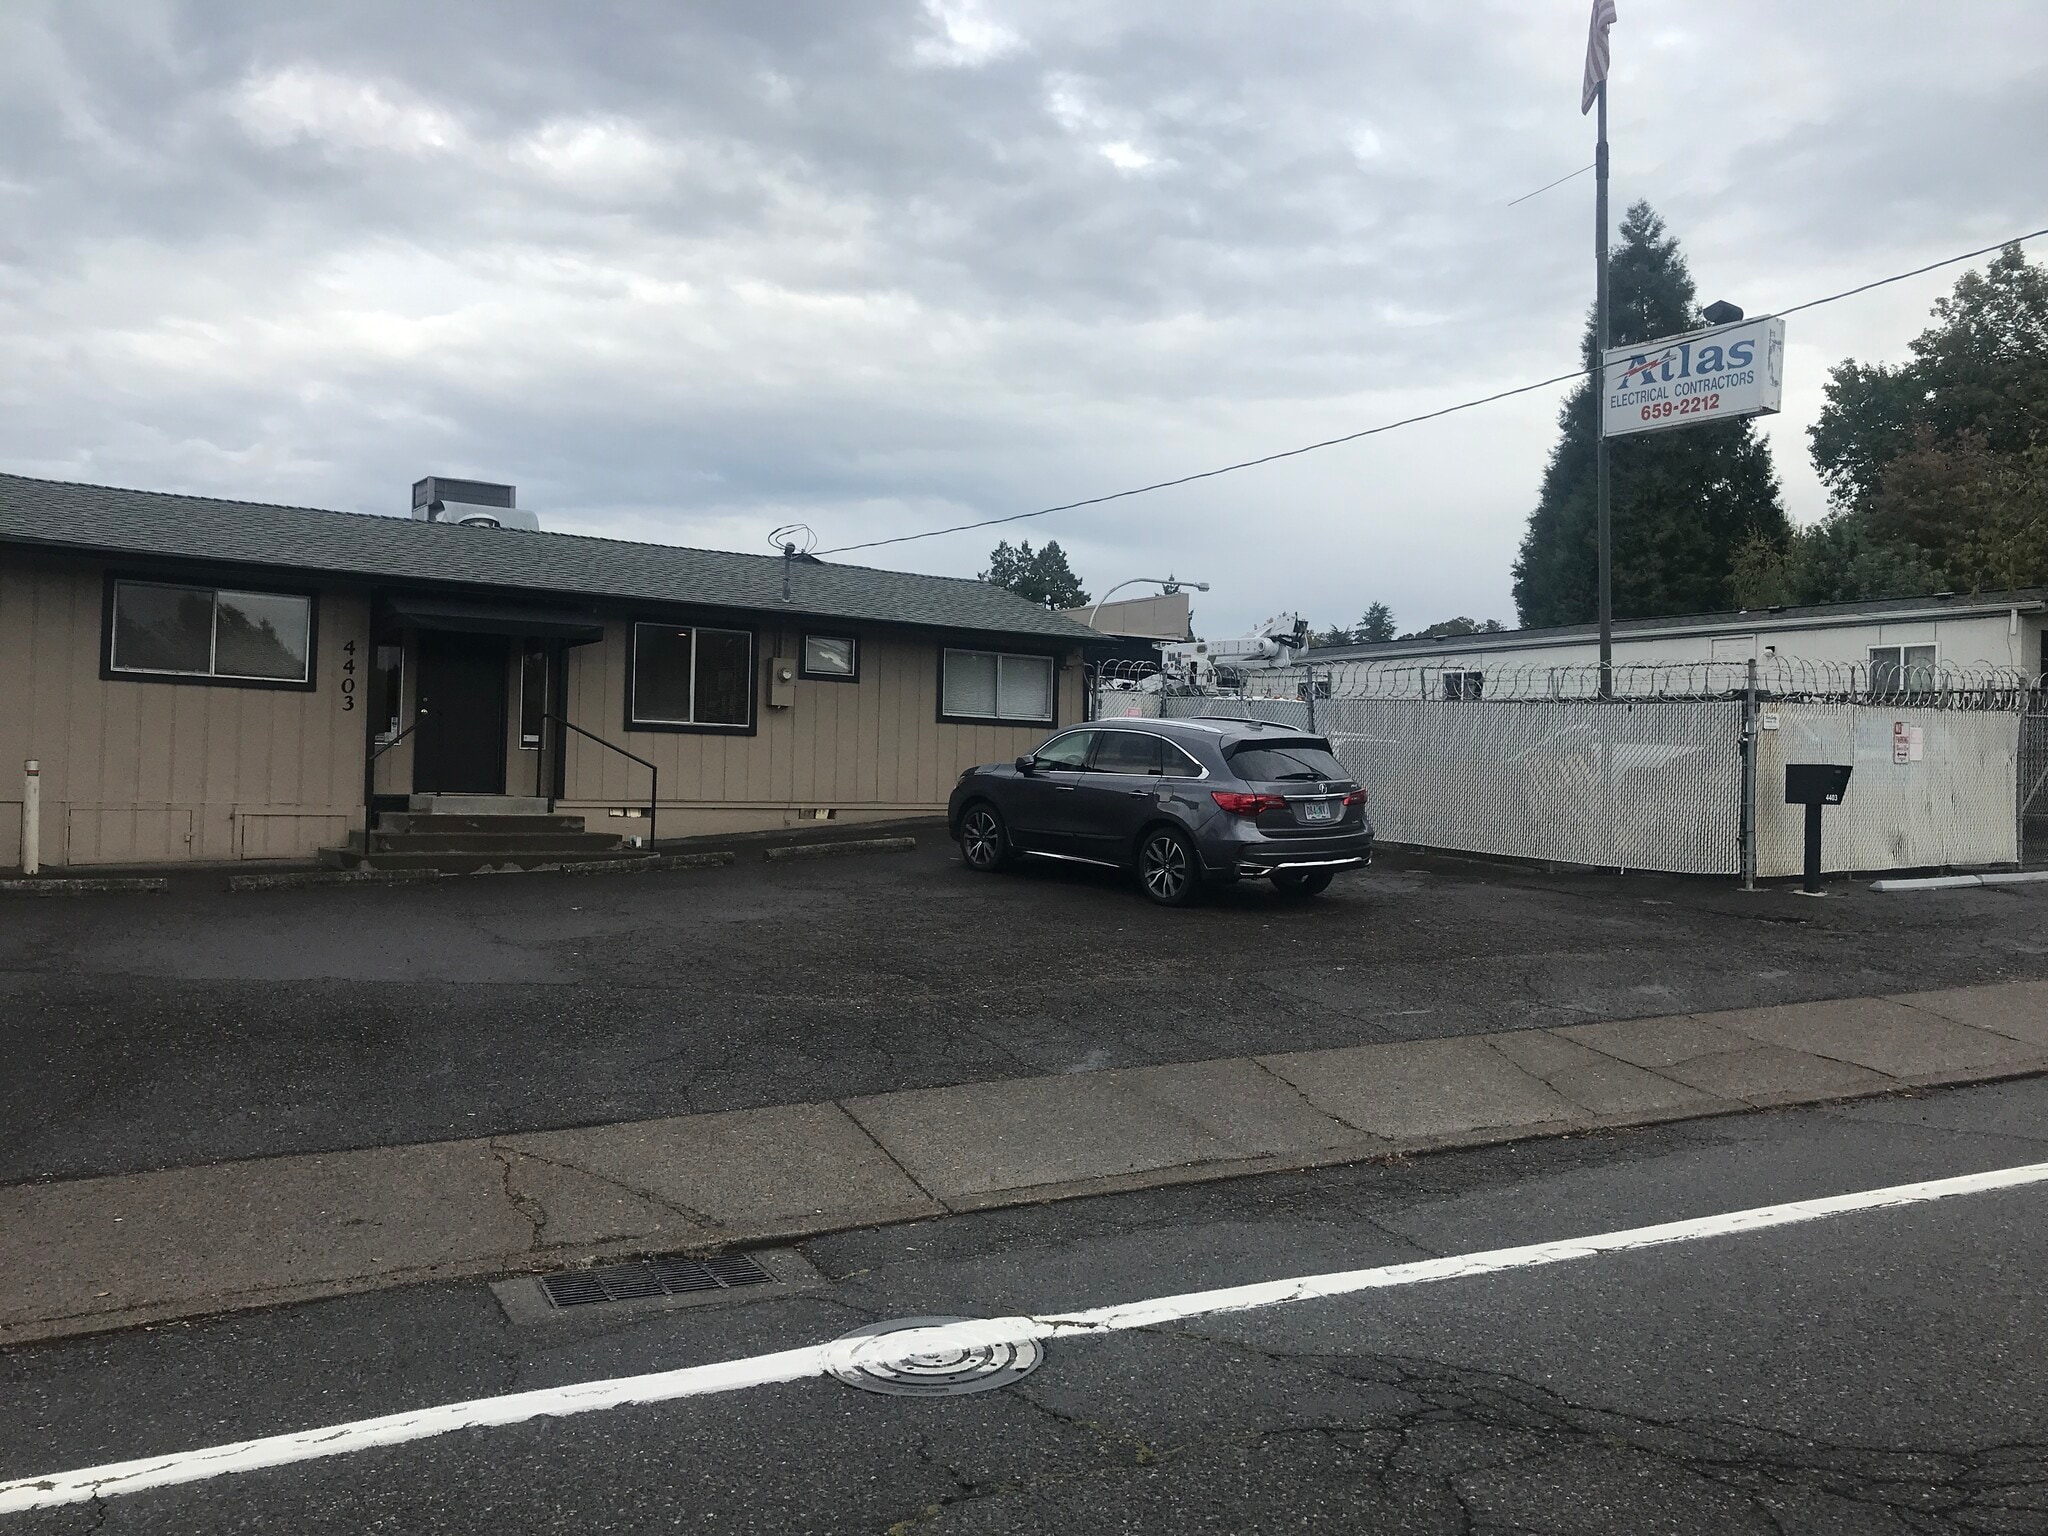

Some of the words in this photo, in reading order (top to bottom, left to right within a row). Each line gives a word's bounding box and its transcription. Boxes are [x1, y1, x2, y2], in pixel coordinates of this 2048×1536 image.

[1616, 339, 1756, 391] Atlas
[1610, 386, 1669, 409] ELECTRICAL
[1674, 370, 1754, 397] CONTRACTORS
[1640, 393, 1720, 421] 659-2212
[341, 640, 356, 711] 4403
